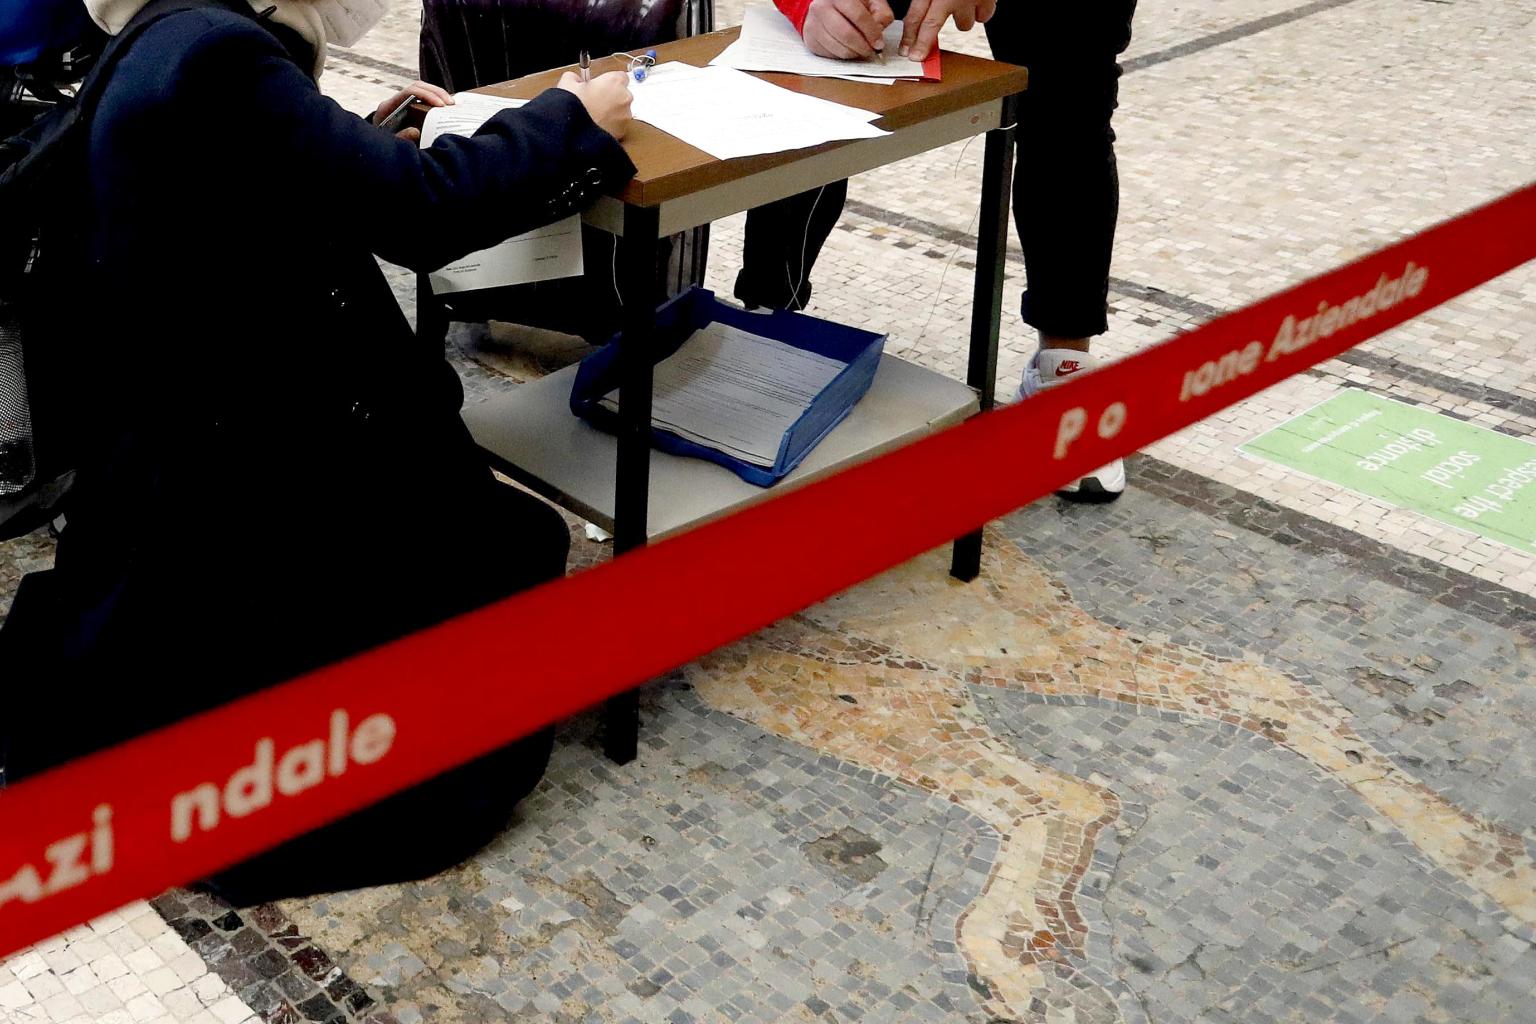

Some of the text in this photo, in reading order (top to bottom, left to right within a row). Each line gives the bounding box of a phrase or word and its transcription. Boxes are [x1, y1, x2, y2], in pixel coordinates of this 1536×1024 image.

[1265, 261, 1430, 363] Aziendale
[1060, 359, 1080, 371] NIKE
[1356, 428, 1444, 471] distance
[1421, 450, 1482, 489] social
[1453, 494, 1504, 519] the
